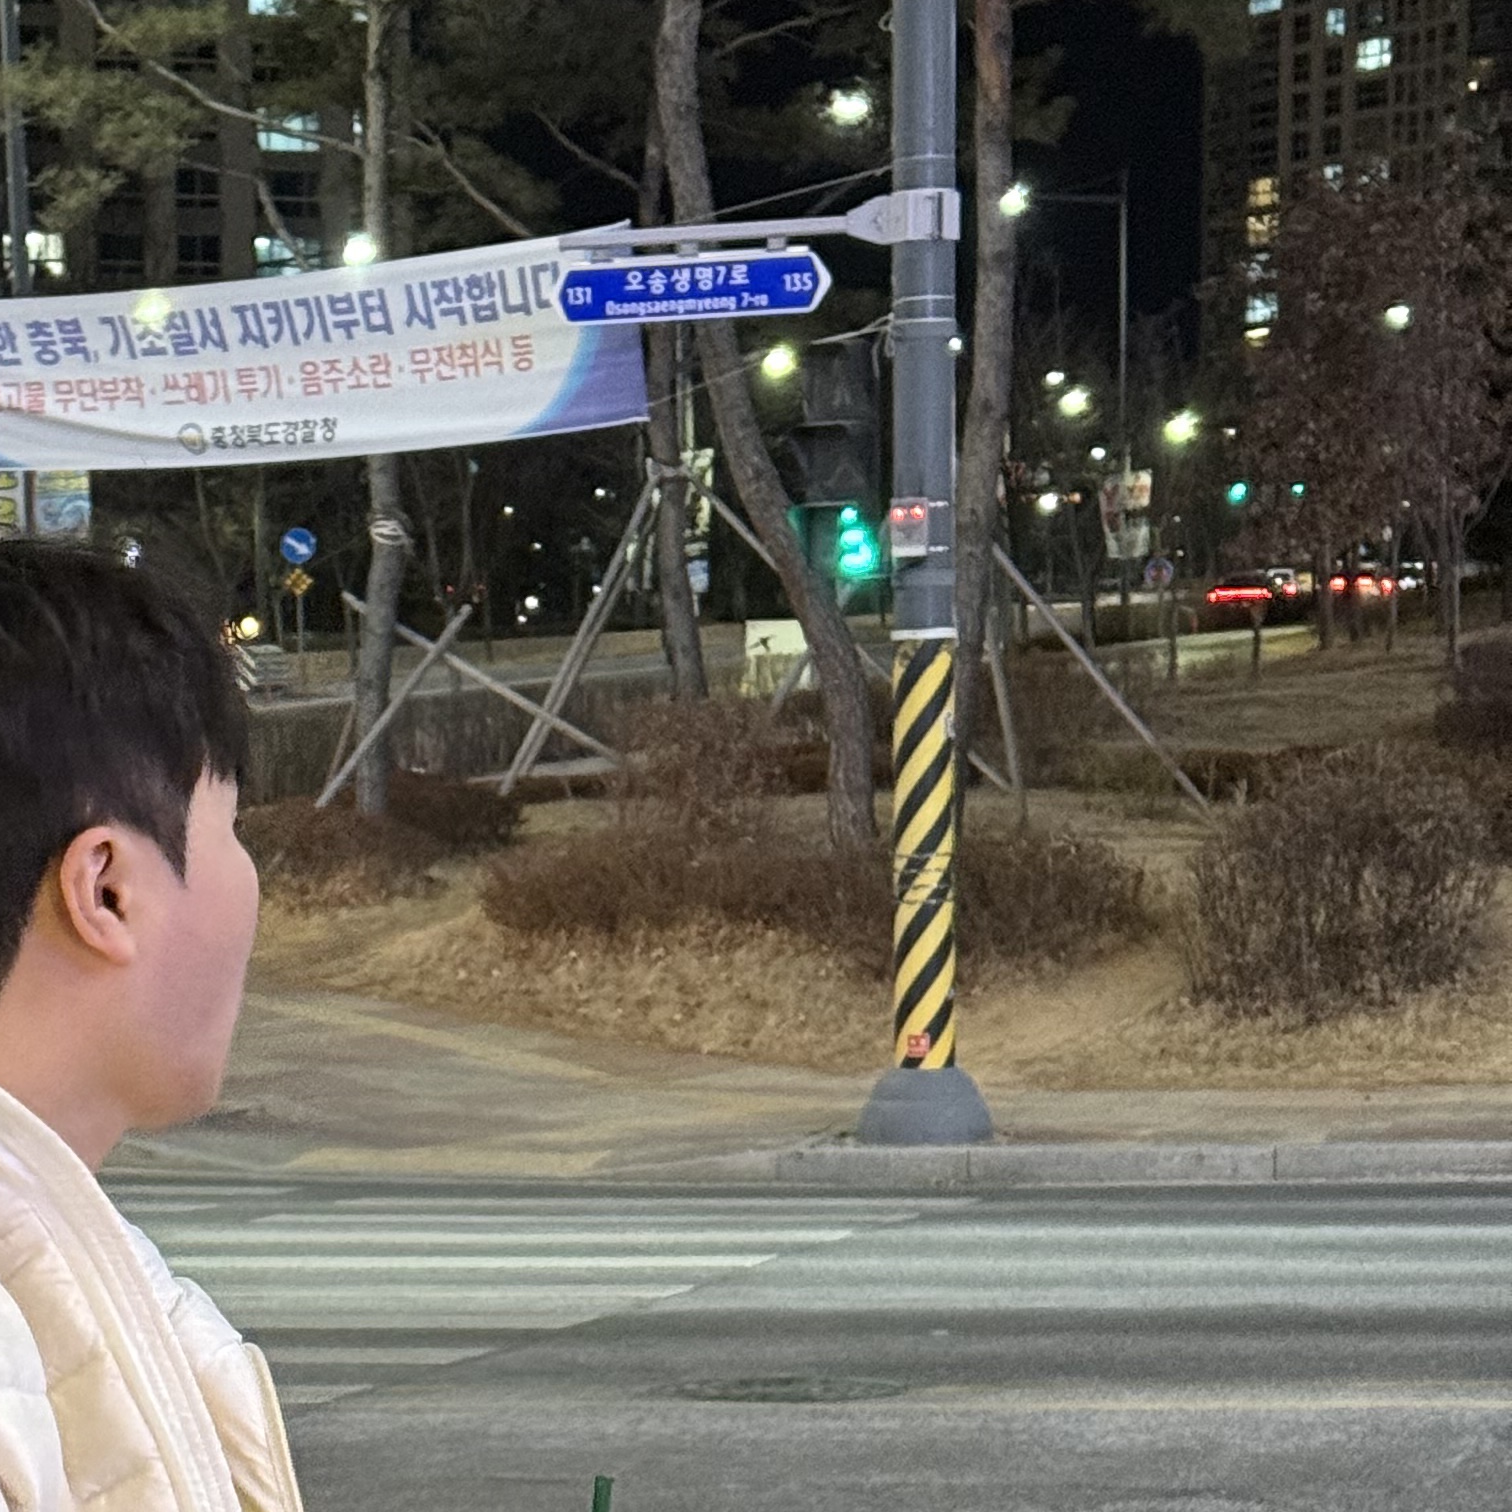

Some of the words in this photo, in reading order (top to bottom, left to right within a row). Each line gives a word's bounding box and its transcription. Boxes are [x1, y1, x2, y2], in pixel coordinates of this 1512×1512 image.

[624, 264, 750, 295] 오송생명7로
[782, 272, 814, 292] 135
[565, 286, 593, 306] 131
[24, 316, 100, 367] 충북,
[232, 290, 394, 349] 지키기부터
[53, 374, 145, 413] 무단부착
[162, 368, 231, 406] 쓰레기
[236, 363, 284, 401] 투기
[299, 352, 393, 397] 음주소란
[409, 337, 506, 384] 무전취식
[511, 333, 535, 373] 등
[210, 416, 338, 449] 충청북도경찰청
